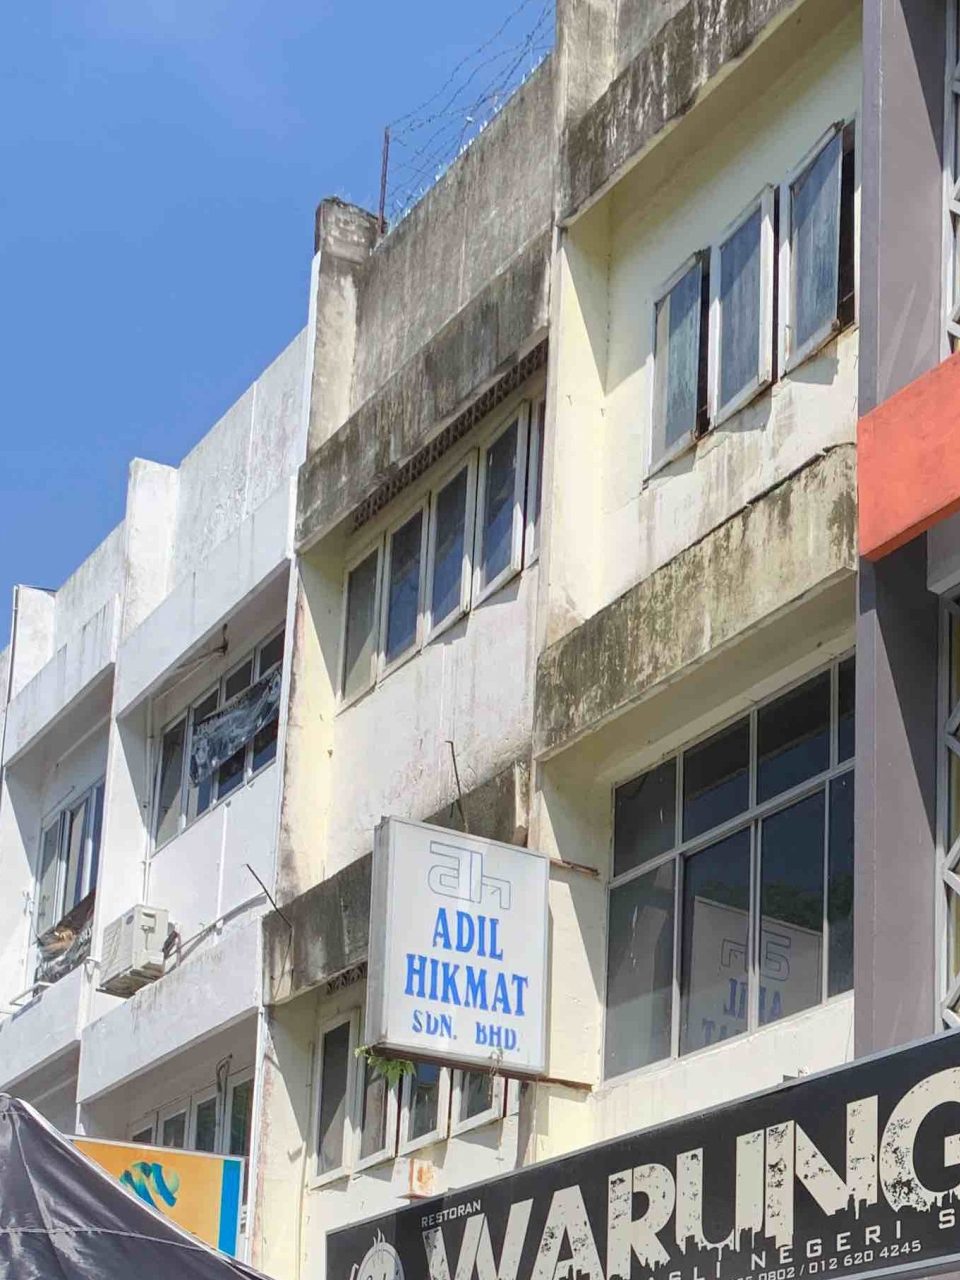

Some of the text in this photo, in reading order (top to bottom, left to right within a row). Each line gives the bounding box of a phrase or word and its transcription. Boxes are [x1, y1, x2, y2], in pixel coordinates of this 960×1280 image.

[432, 907, 504, 961] ADIL
[404, 953, 529, 1017] HIKMAT
[411, 1009, 521, 1052] SDN. BHD.
[421, 1199, 482, 1229] RESTORAN
[751, 1220, 902, 1272] NEGERI
[808, 1257, 838, 1275] 012
[843, 1250, 874, 1268] 620
[879, 1239, 922, 1260] 4245
